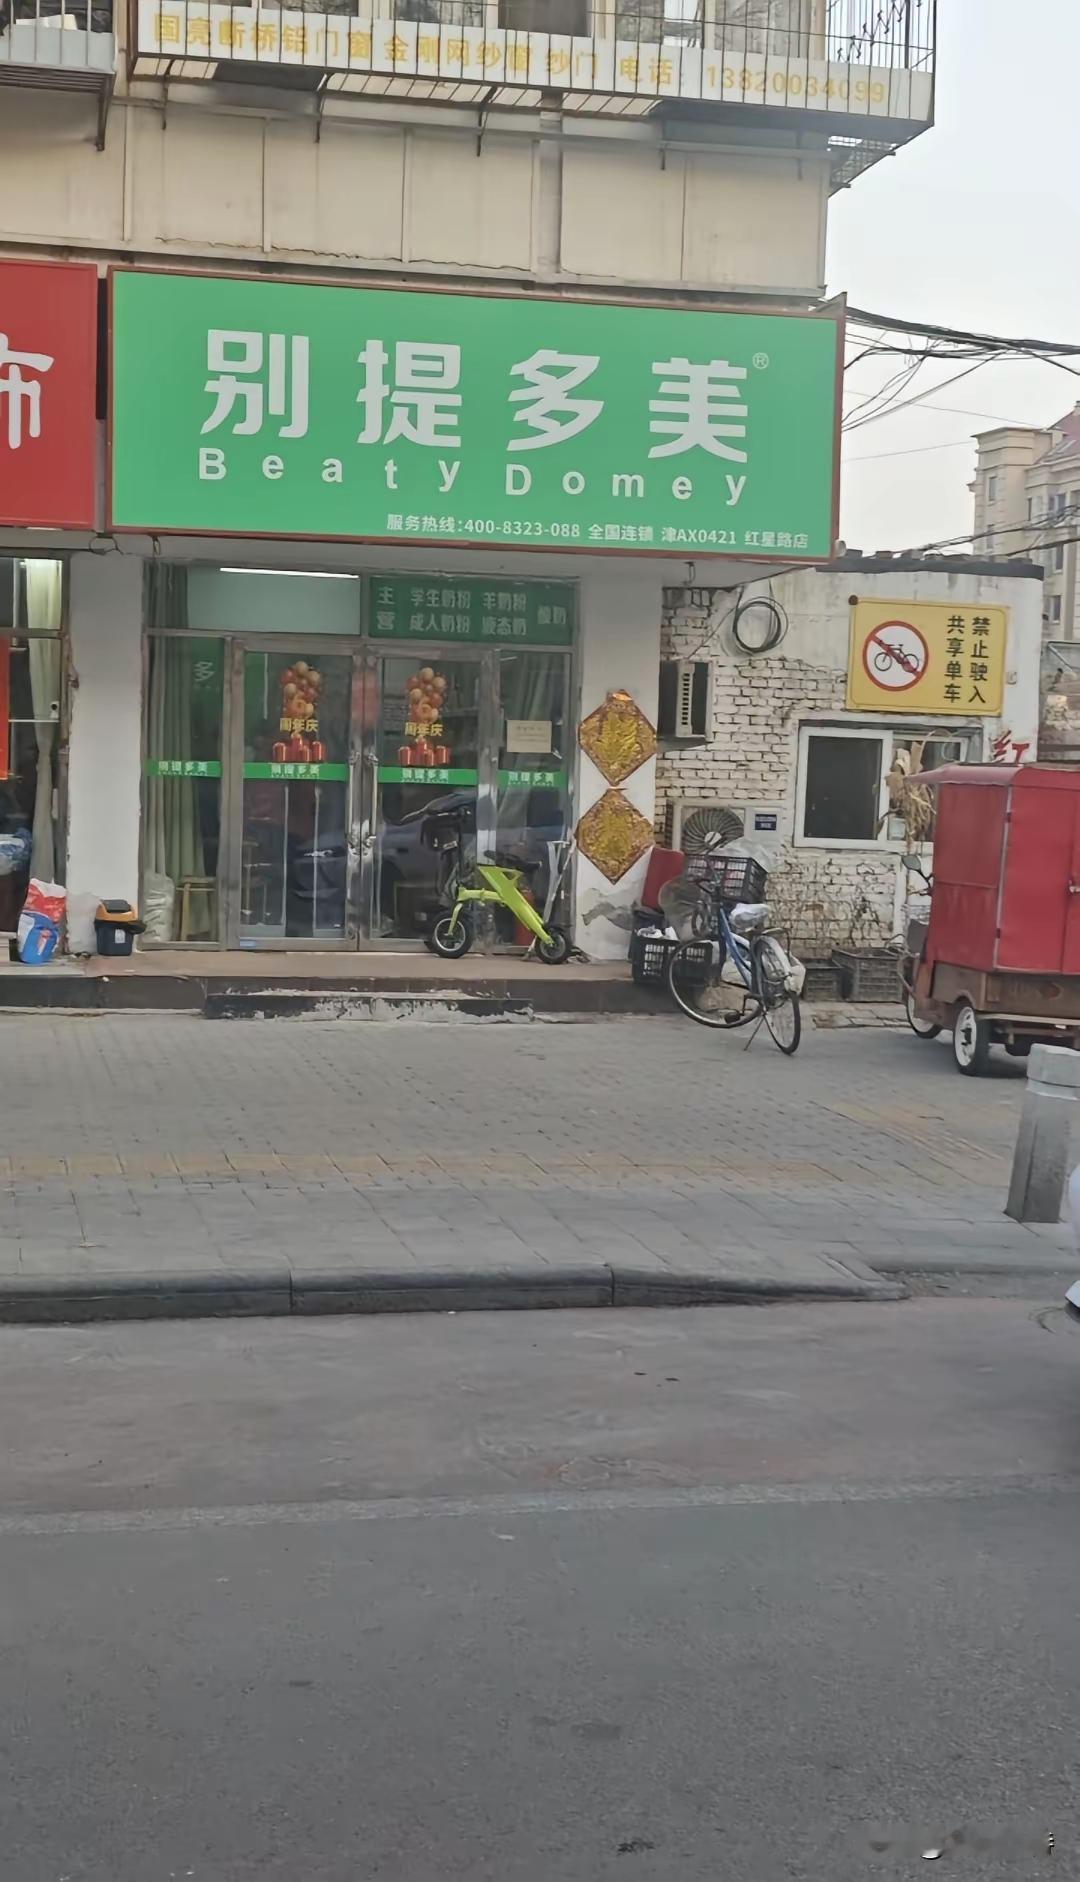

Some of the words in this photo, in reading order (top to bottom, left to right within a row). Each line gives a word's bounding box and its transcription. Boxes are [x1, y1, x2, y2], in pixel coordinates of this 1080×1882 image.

[199, 328, 748, 464] 别提多美
[198, 447, 461, 493] Beaty
[505, 464, 747, 506] Domey
[588, 524, 654, 542] 全国连锁
[661, 526, 737, 545] 津AX0421
[744, 531, 809, 549] 红星路店
[408, 612, 470, 634] 成人奶粉
[409, 586, 471, 609] 学生奶粉
[943, 615, 965, 703] 共享单车
[968, 616, 991, 705] 禁止驶入
